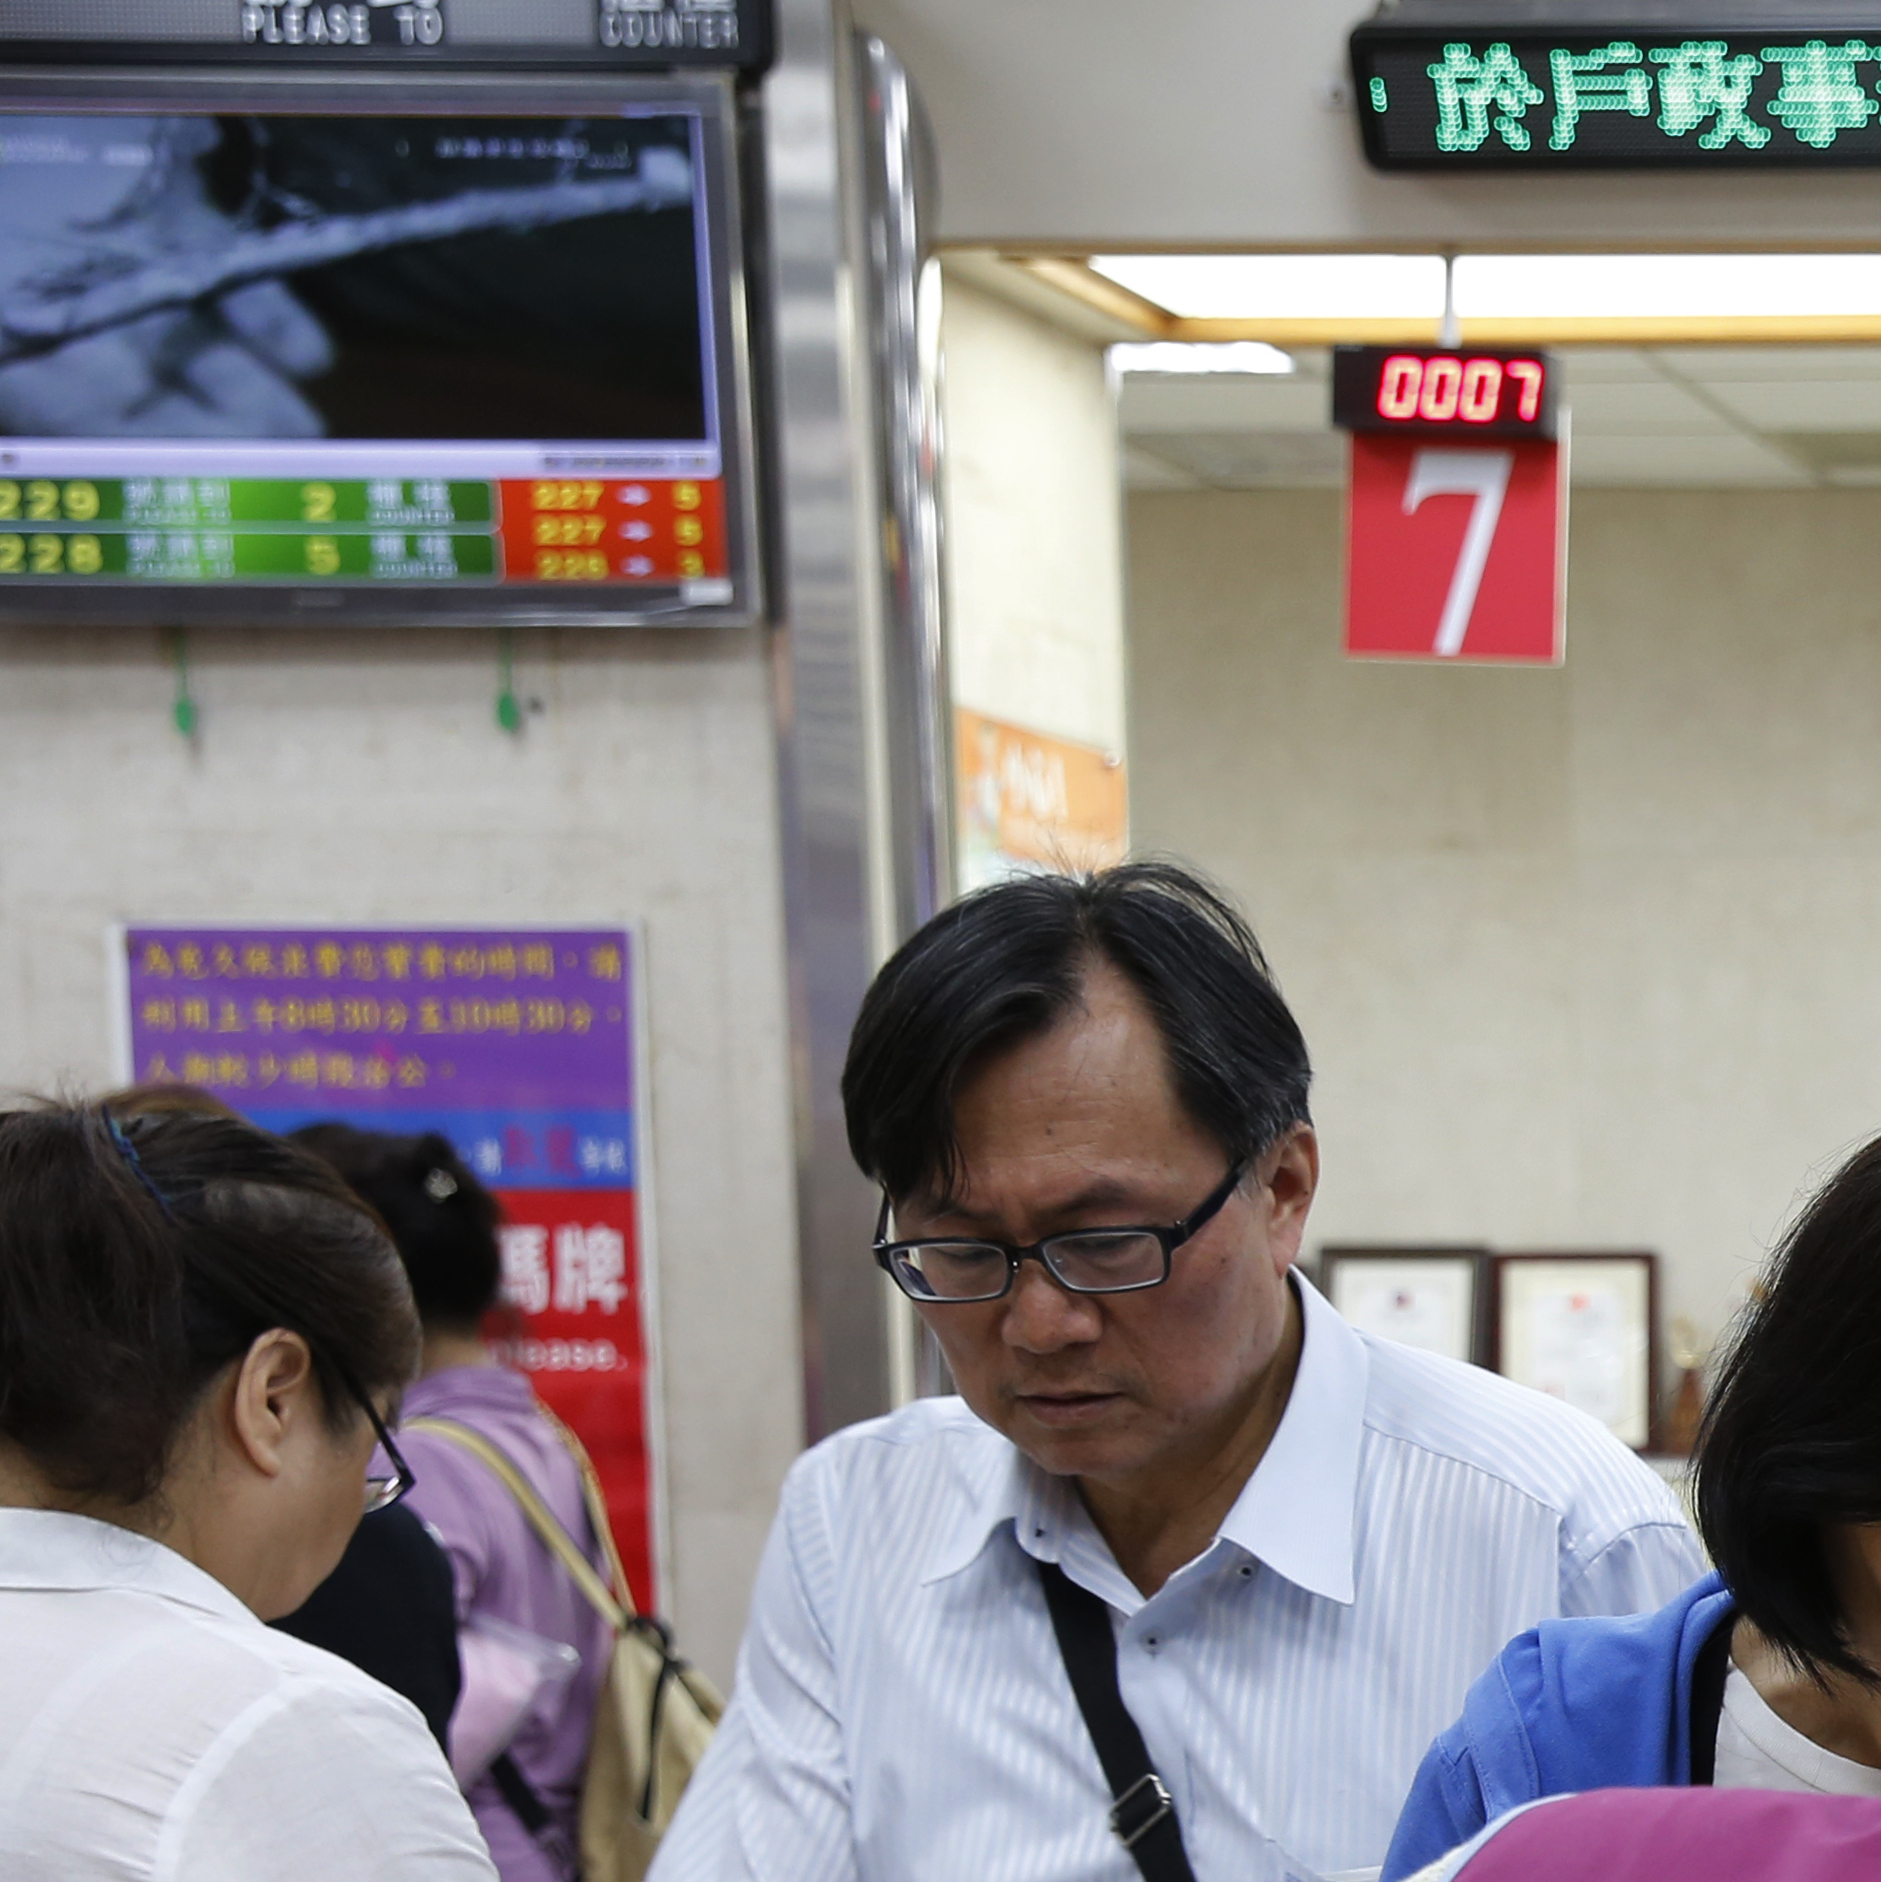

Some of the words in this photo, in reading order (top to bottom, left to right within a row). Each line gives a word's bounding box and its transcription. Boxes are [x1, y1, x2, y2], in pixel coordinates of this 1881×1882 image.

[242, 4, 371, 46] PLEASE
[393, 6, 443, 46] TO
[599, 9, 738, 48] COUNTER
[1377, 355, 1543, 423] 0007
[301, 481, 337, 523] 2
[532, 480, 604, 511] 227
[533, 514, 606, 546] 227
[1402, 450, 1514, 656] 7
